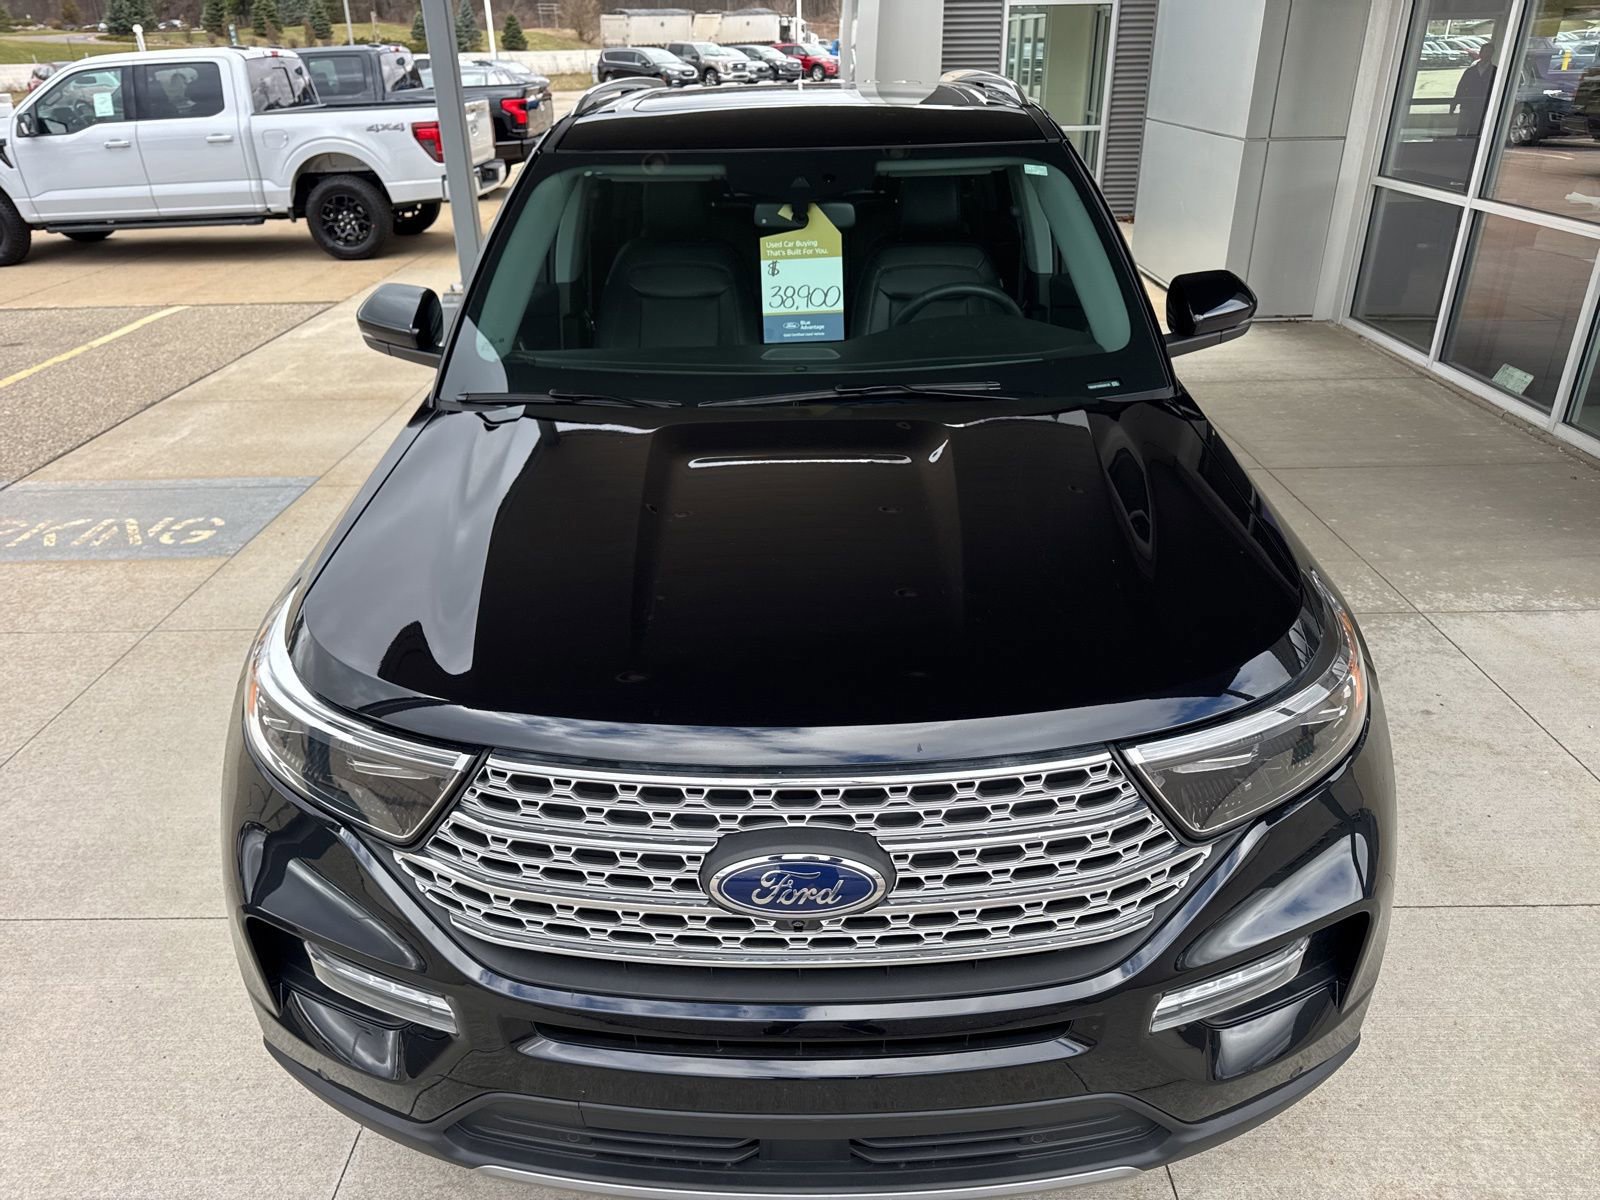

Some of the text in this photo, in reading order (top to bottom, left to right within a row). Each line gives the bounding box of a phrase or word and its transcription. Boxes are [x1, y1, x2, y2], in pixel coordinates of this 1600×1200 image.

[796, 240, 818, 248] Buying
[768, 260, 780, 277] $
[769, 284, 841, 310] 38,900
[752, 870, 844, 905] Ford
